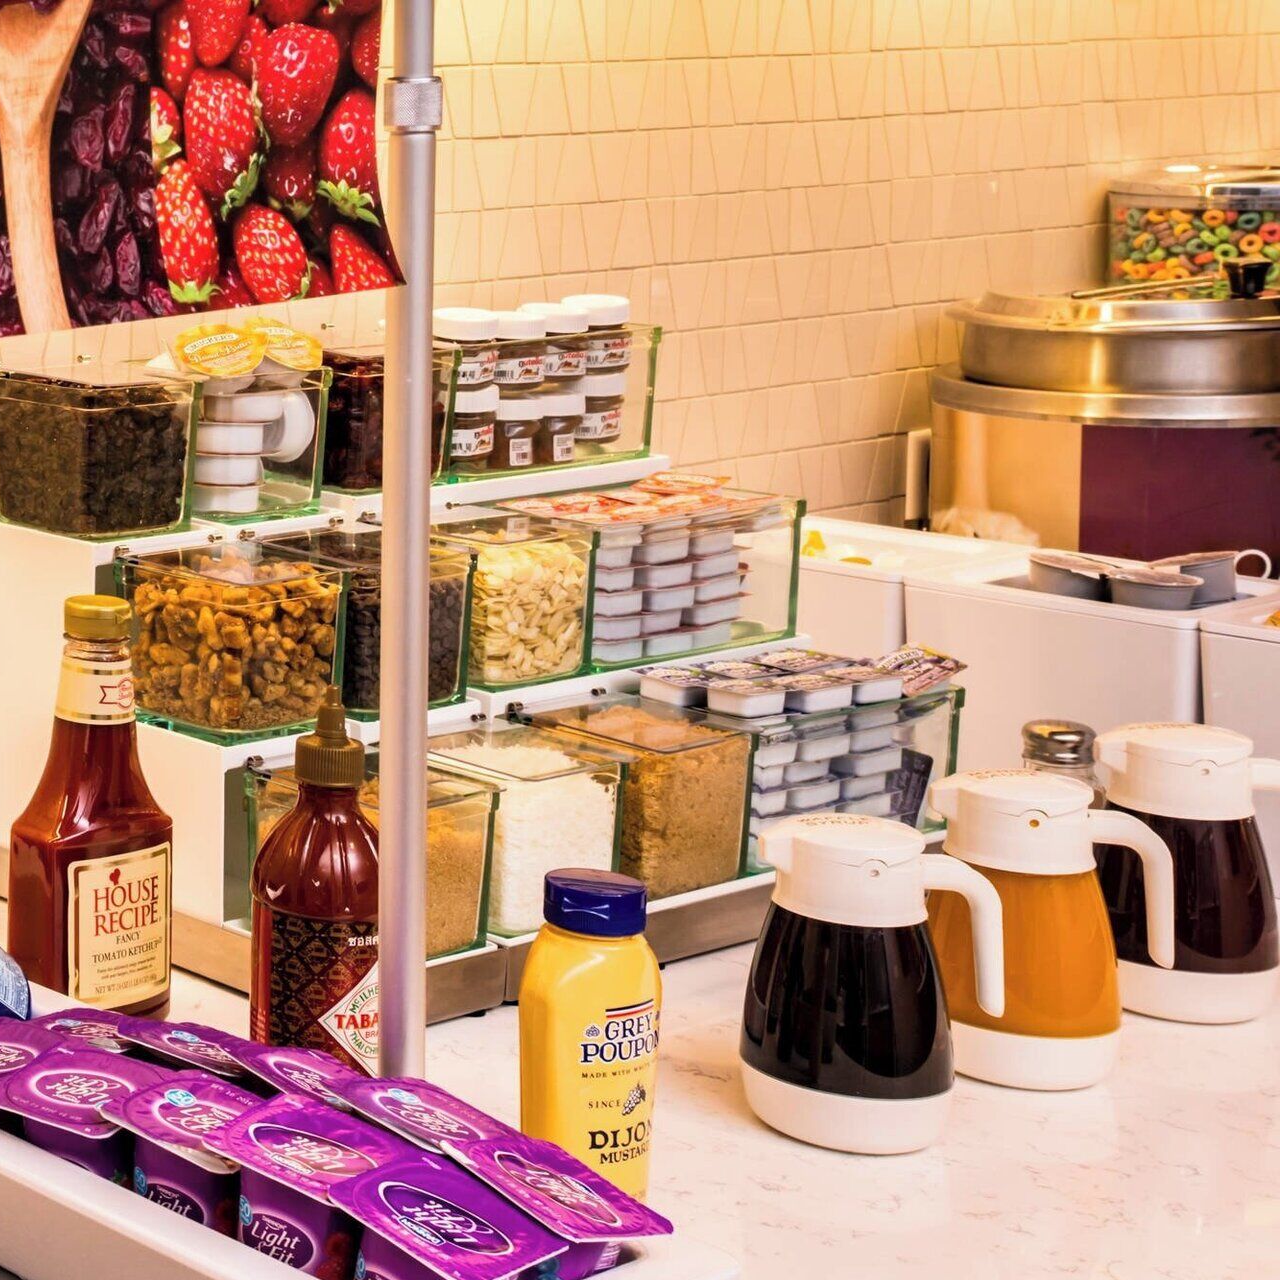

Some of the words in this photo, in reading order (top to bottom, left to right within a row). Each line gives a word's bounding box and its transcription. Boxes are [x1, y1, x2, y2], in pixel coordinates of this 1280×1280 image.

[93, 876, 159, 913] HOUSE
[93, 901, 158, 937] RECIPE
[116, 931, 141, 945] FANCY
[92, 948, 127, 964] TOMATO
[334, 1013, 379, 1030] TABA
[605, 1012, 653, 1041] GREY
[365, 1031, 379, 1039] BRA
[581, 1071, 607, 1079] MADE
[611, 1068, 631, 1077] WITH
[45, 1083, 110, 1102] Light
[588, 1099, 621, 1109] SINCE
[272, 1142, 346, 1171] Light
[251, 1220, 300, 1250] Light
[401, 1217, 442, 1244] DANNON
[402, 1206, 479, 1243] Light
